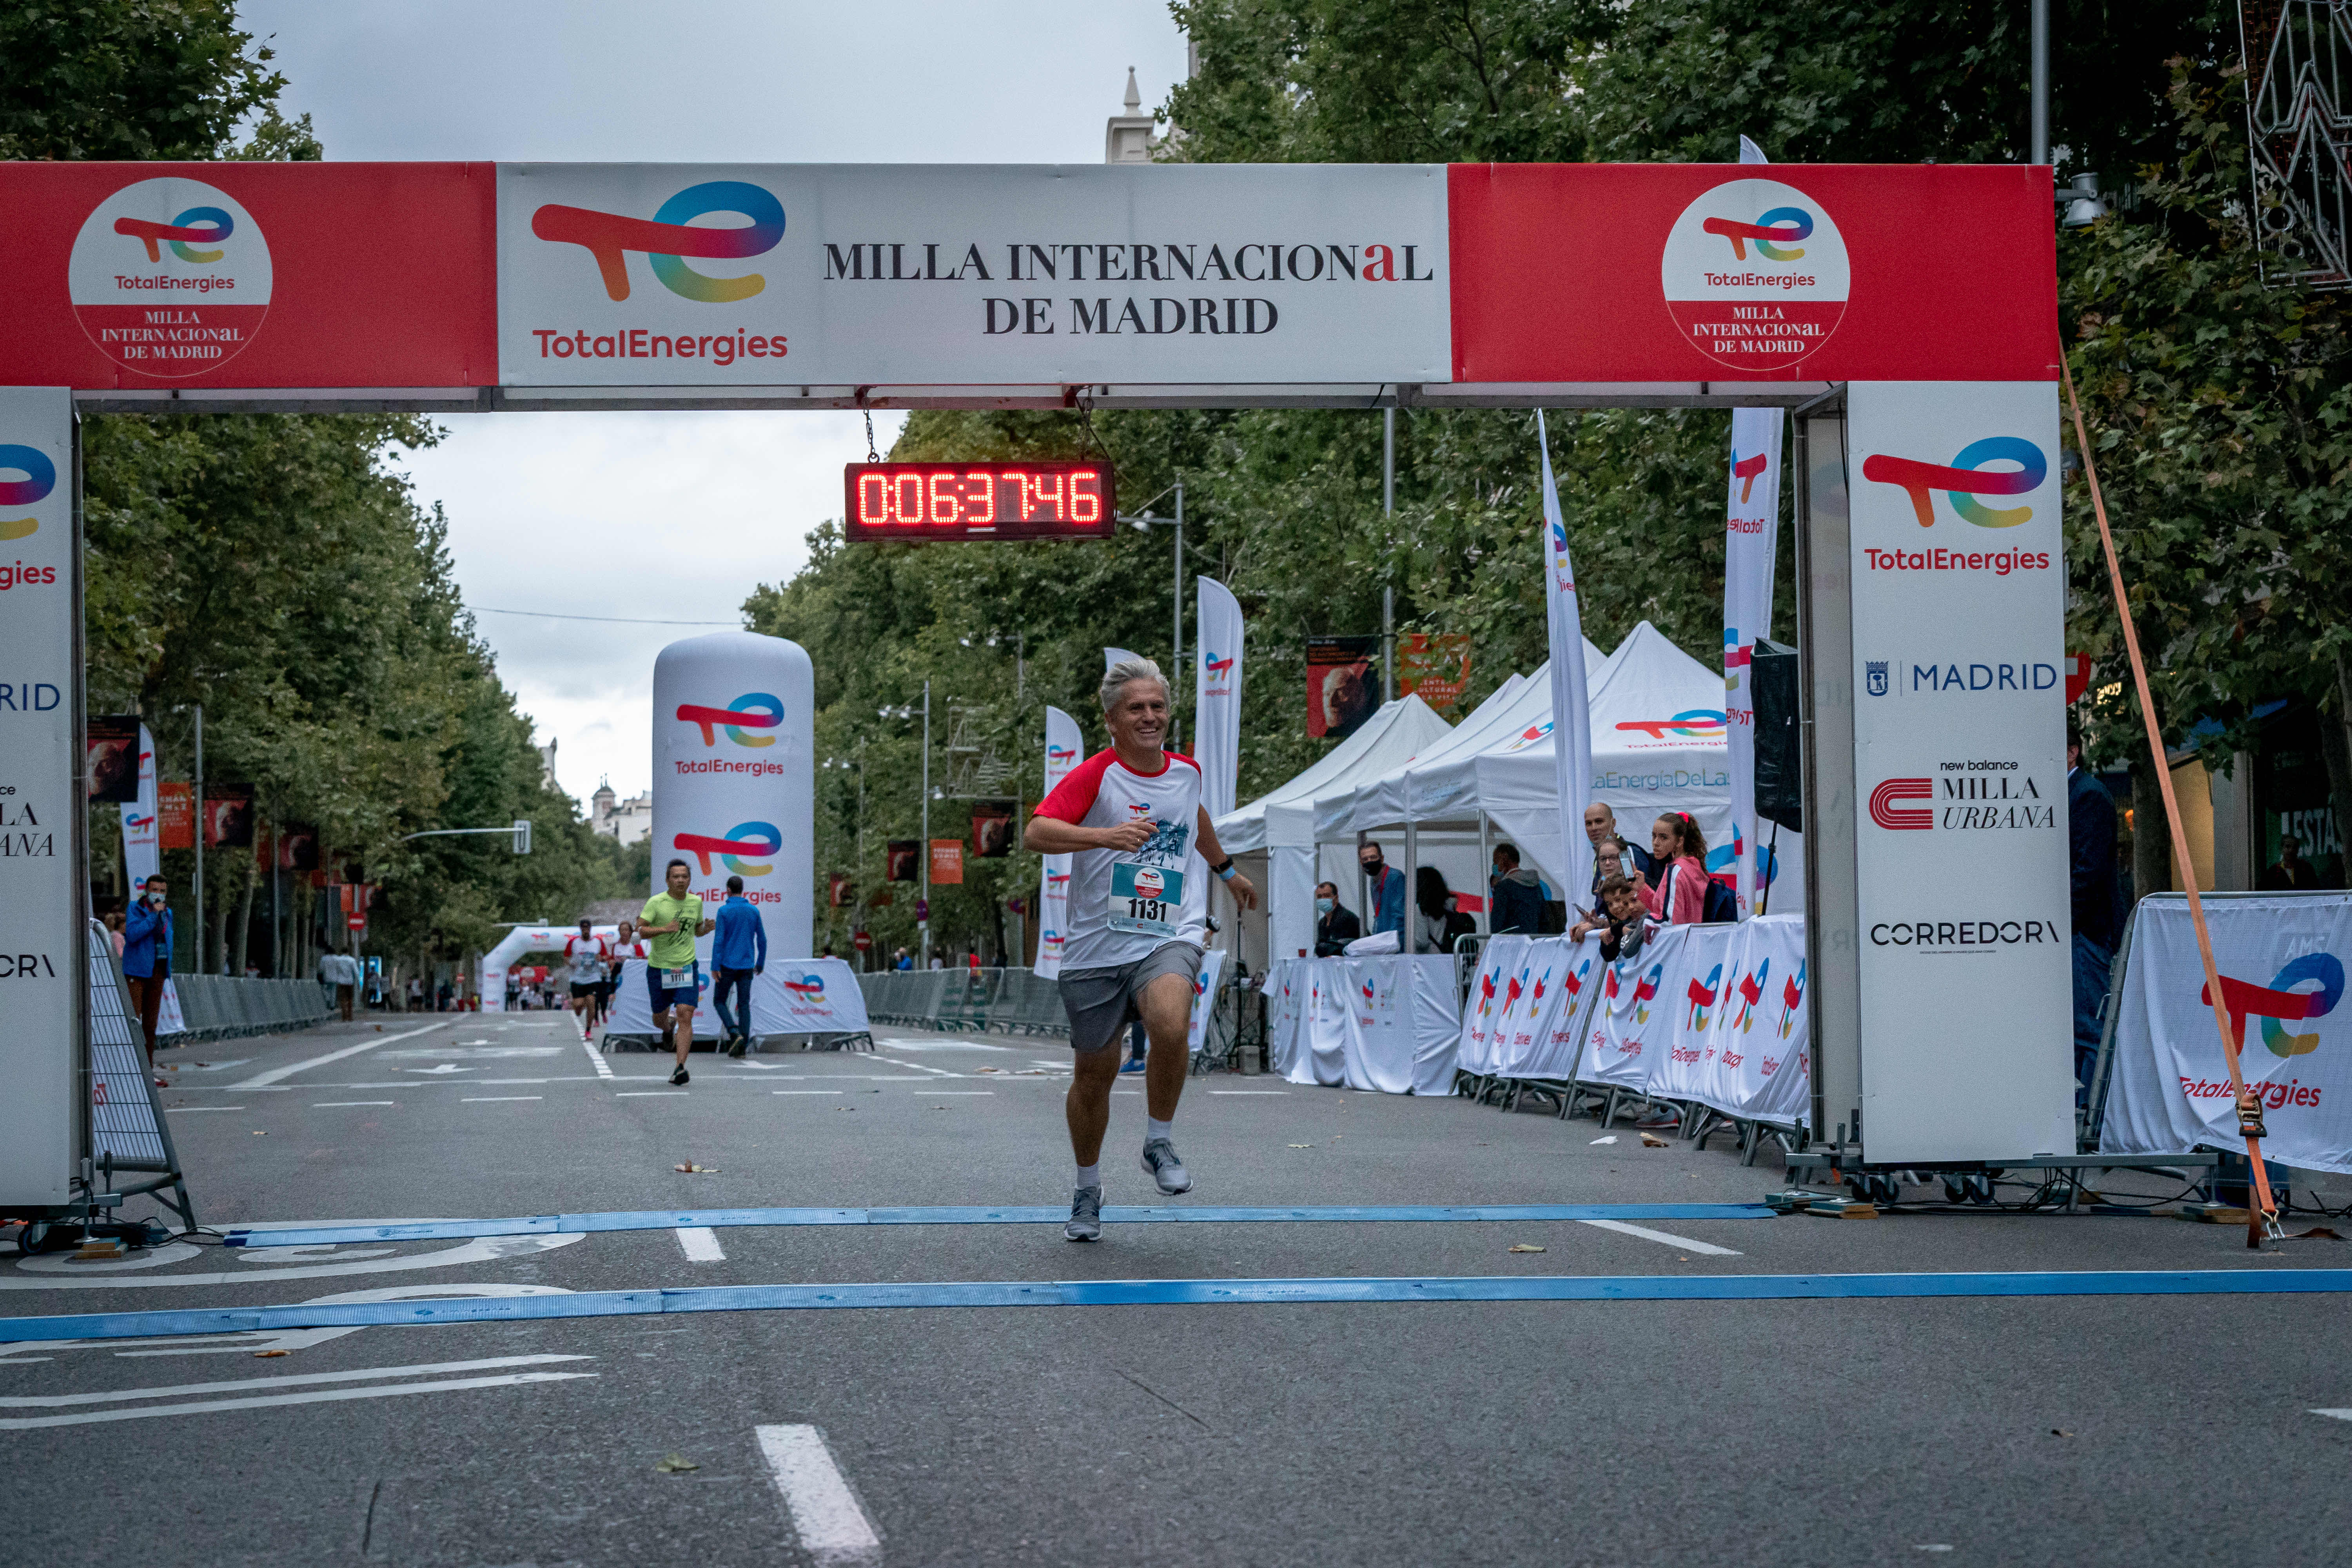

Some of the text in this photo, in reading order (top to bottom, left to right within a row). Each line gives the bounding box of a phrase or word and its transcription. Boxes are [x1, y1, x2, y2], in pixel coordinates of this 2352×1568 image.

[823, 242, 994, 280] MILLA
[114, 275, 234, 293] TotalEnergies
[1704, 272, 1815, 289] TotalEnergies
[145, 311, 201, 324] MILLA
[983, 297, 1278, 334] DE MADRID
[1733, 307, 1784, 319] MILLA
[124, 346, 222, 359] DE MADRID
[532, 328, 788, 365] TotalEnergies
[1714, 340, 1805, 353] DE MADRID
[1864, 546, 2049, 575] TotalEnergies
[1913, 663, 2057, 691] MADRID
[675, 759, 783, 777] TotalEnergies
[1940, 760, 2018, 771] new balance
[1943, 777, 2041, 800] MILLA
[1943, 805, 2056, 829] URBANA
[1128, 898, 1167, 922] 1131
